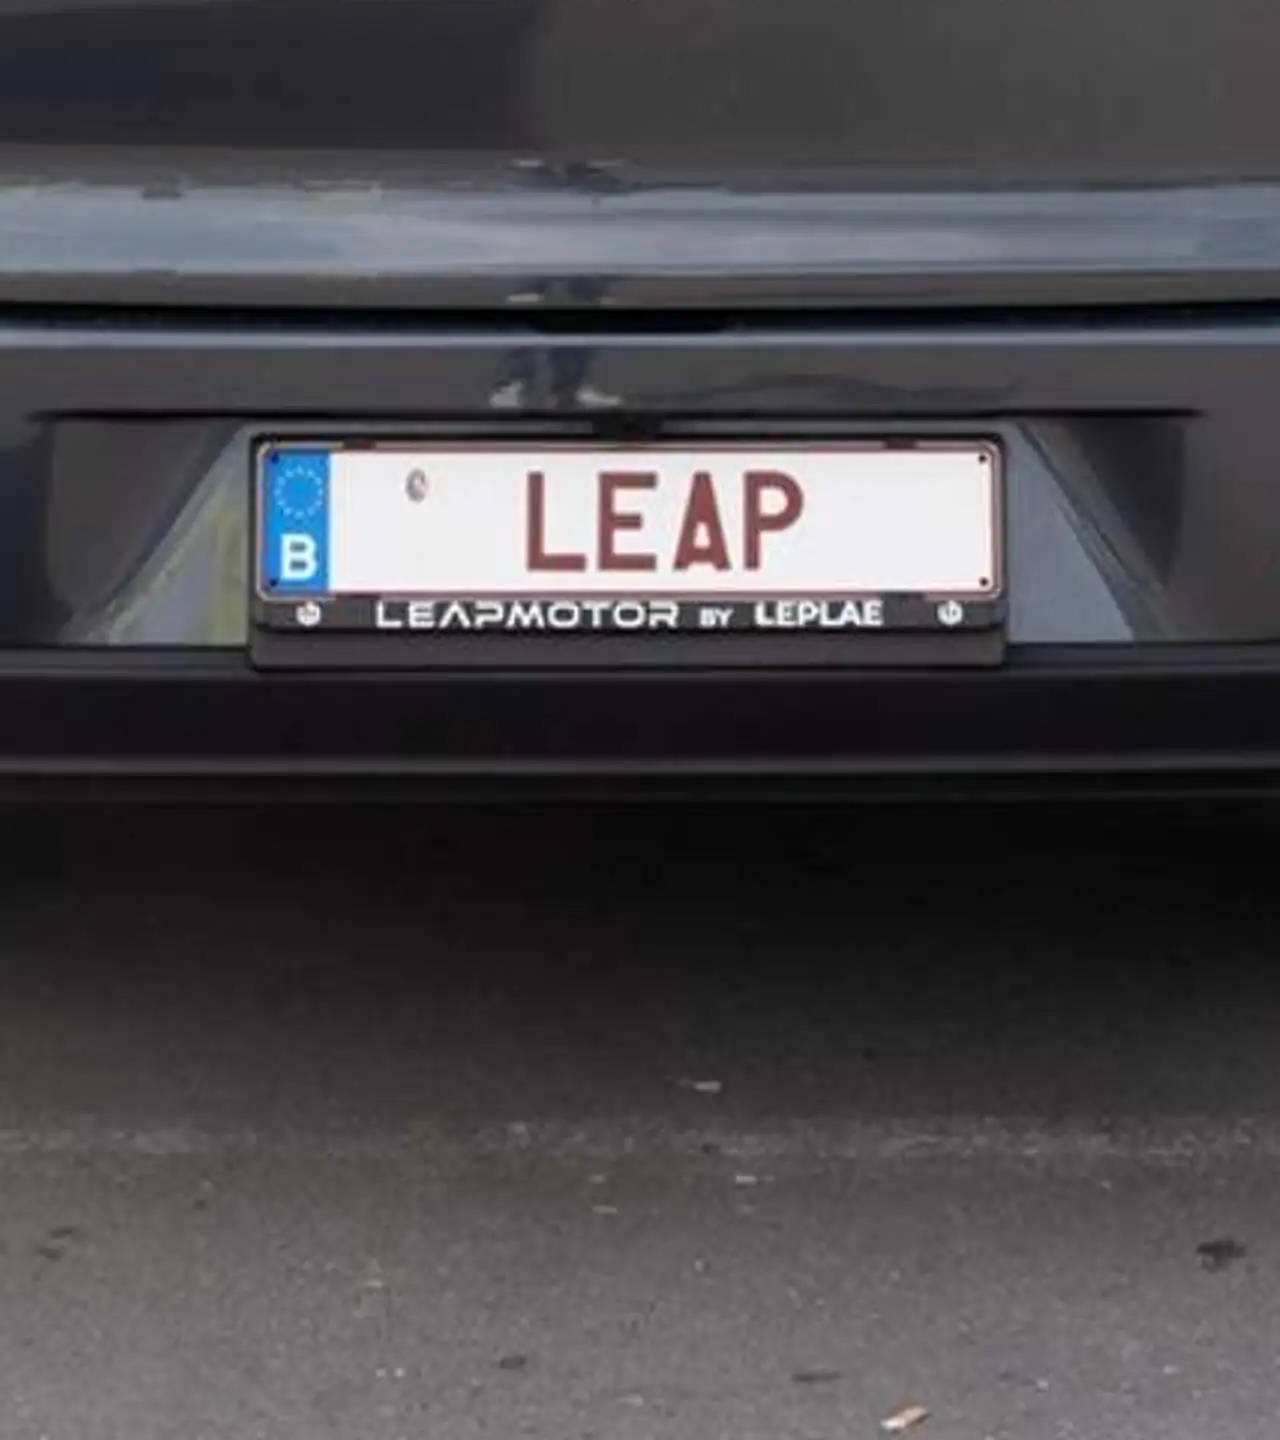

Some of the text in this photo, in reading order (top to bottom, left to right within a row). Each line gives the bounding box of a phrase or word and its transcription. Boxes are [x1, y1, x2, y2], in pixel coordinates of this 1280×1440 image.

[279, 470, 804, 580] B LEAP
[376, 600, 884, 629] LEAPMOTOR BY LEPLAE
